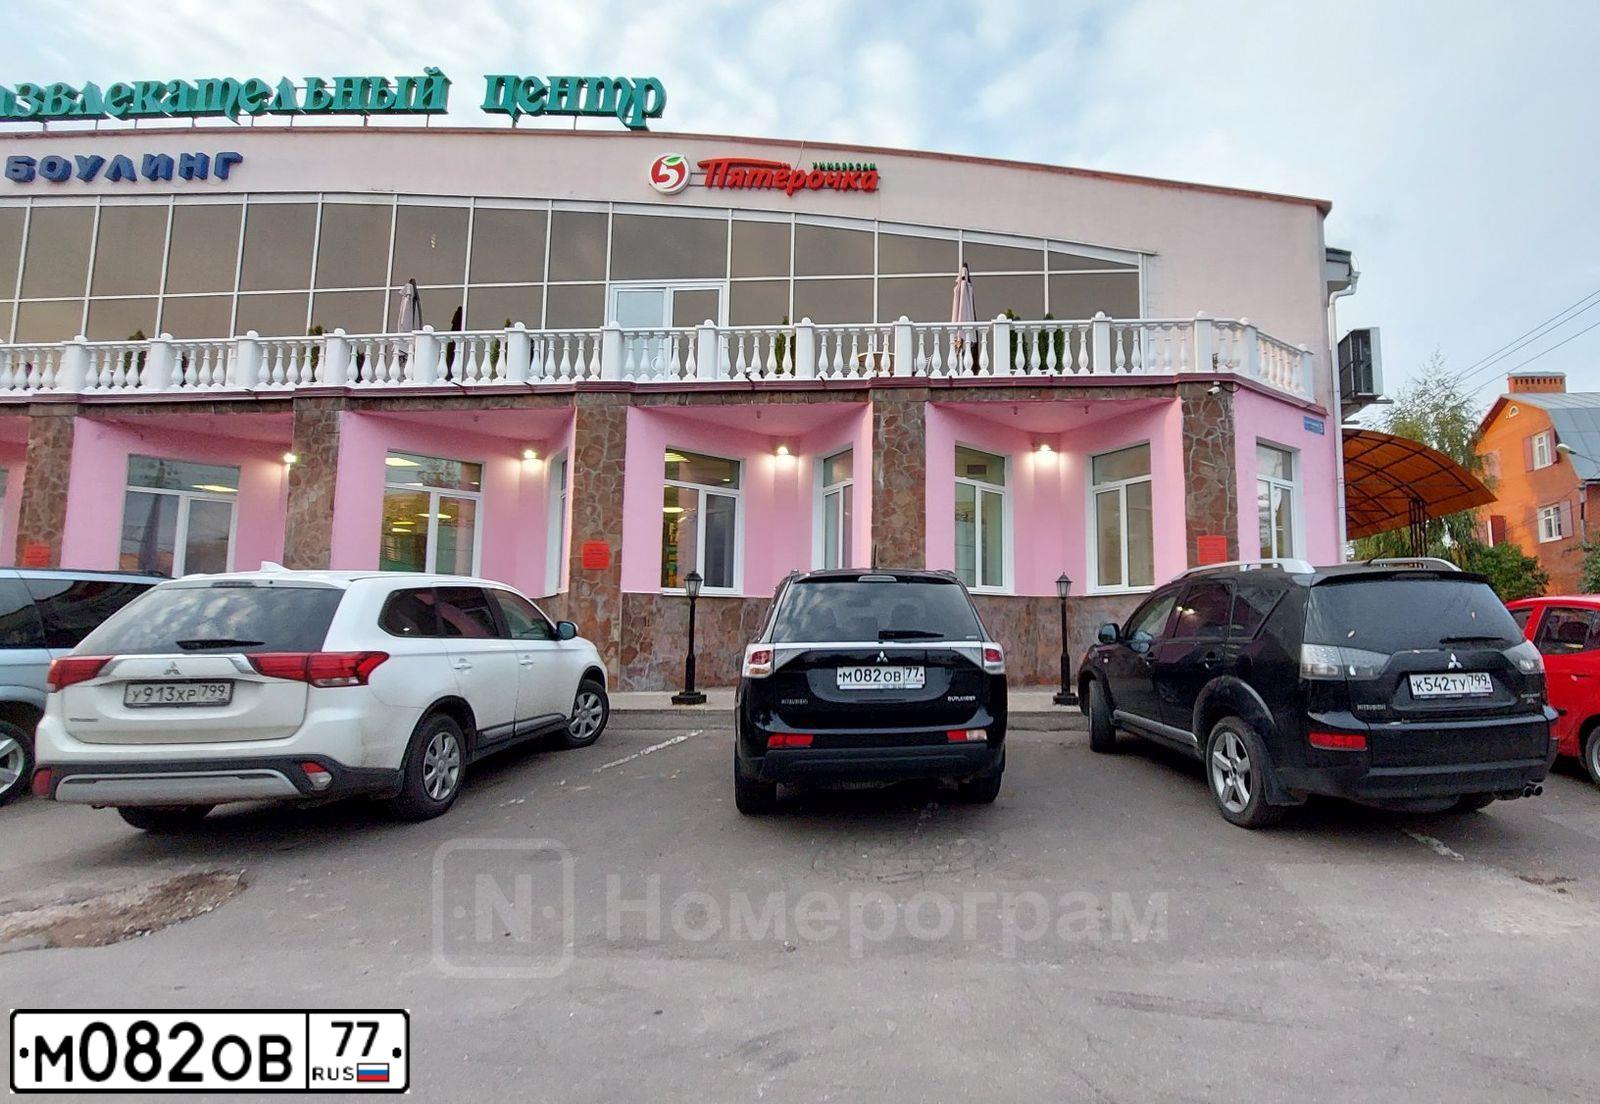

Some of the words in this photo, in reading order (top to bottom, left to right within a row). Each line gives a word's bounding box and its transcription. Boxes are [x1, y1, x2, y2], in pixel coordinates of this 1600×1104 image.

[481, 75, 667, 131] центр
[5, 152, 243, 183] БОУЛИНГ
[842, 668, 901, 682] М082ОВ
[905, 667, 920, 678] 77
[1468, 674, 1487, 686] 799
[201, 684, 226, 697] 799
